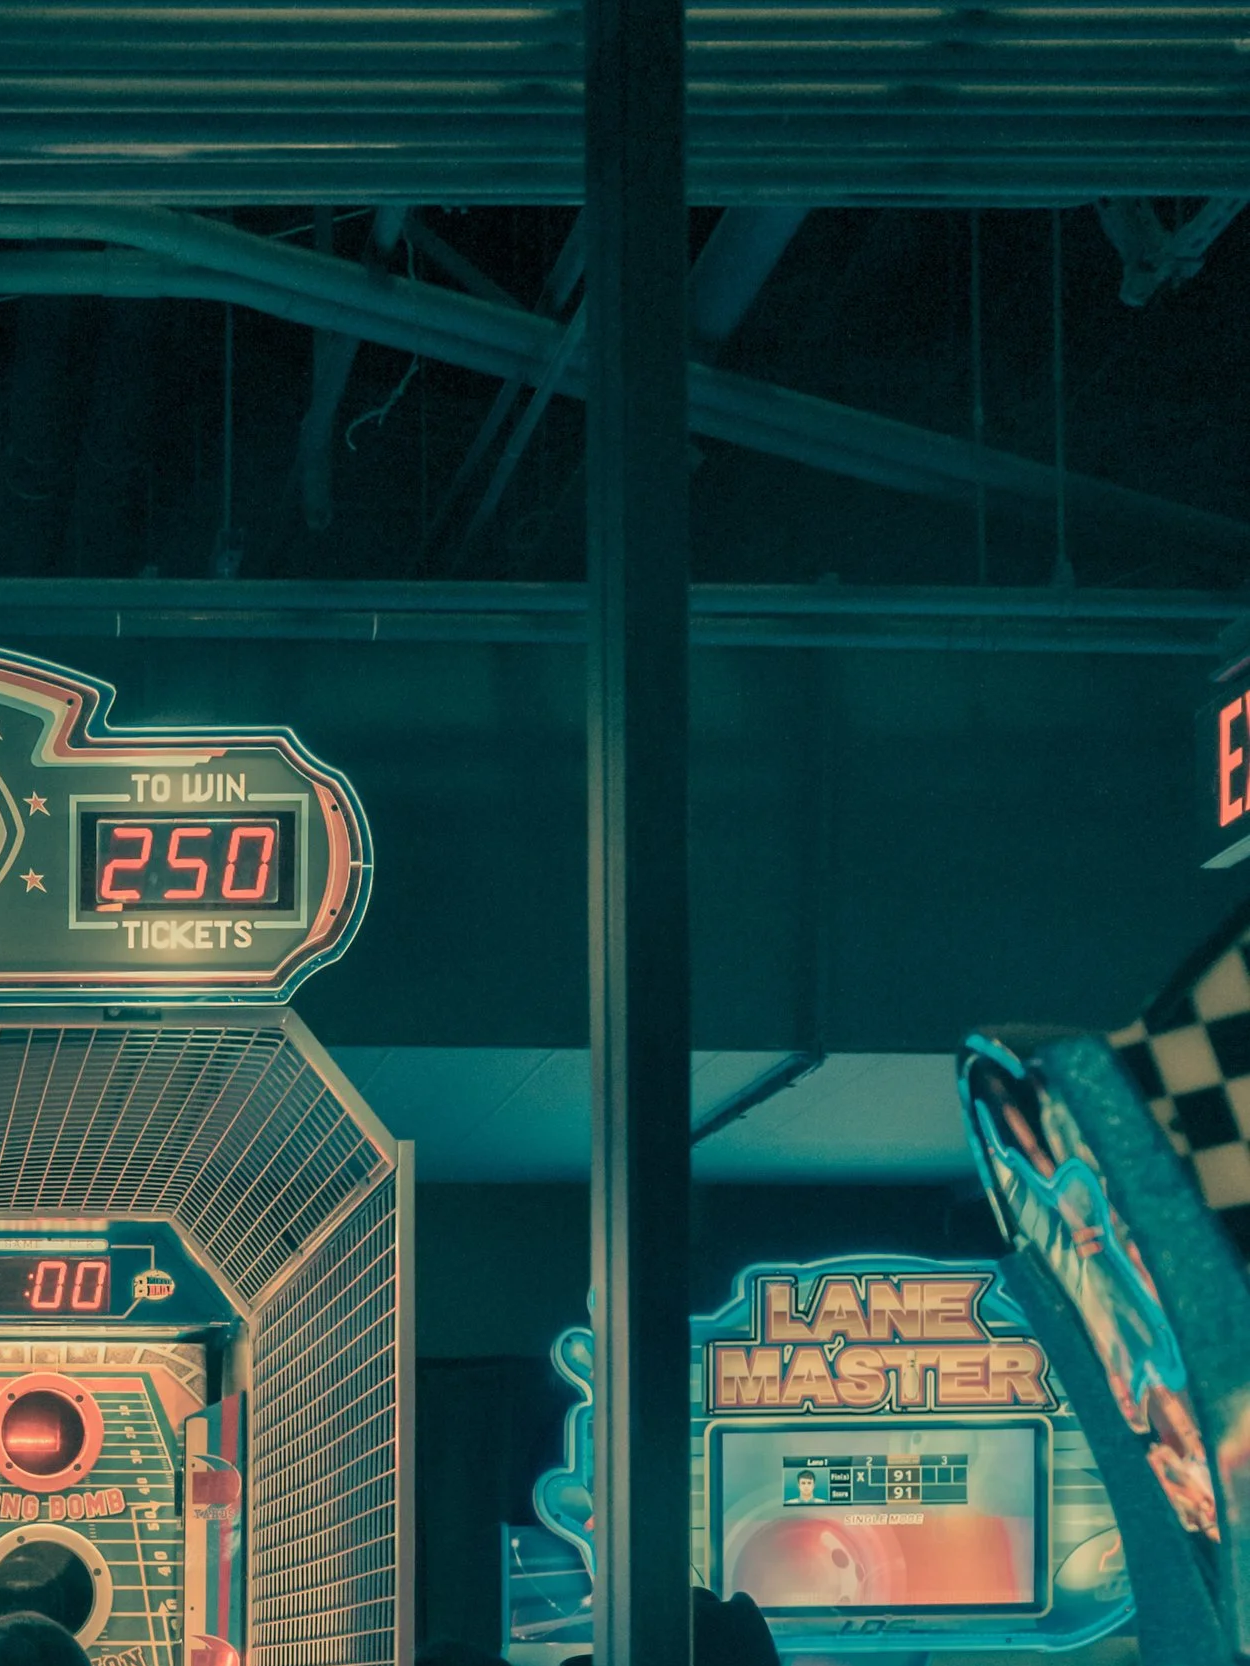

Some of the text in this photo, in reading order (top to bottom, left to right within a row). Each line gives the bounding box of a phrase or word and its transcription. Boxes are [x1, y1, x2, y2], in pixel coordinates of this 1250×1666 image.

[1219, 690, 1250, 828] E
[132, 772, 247, 802] TO WIN
[98, 825, 275, 900] 250
[121, 919, 254, 950] TICKETS
[768, 1277, 984, 1341] LANE
[715, 1343, 1052, 1409] MASTER
[865, 1456, 873, 1467] 2
[893, 1469, 913, 1482] 91
[941, 1456, 948, 1466] 3
[47, 1487, 127, 1521] BOMB
[893, 1487, 913, 1499] 91
[844, 1513, 925, 1525] SINGLE MODE
